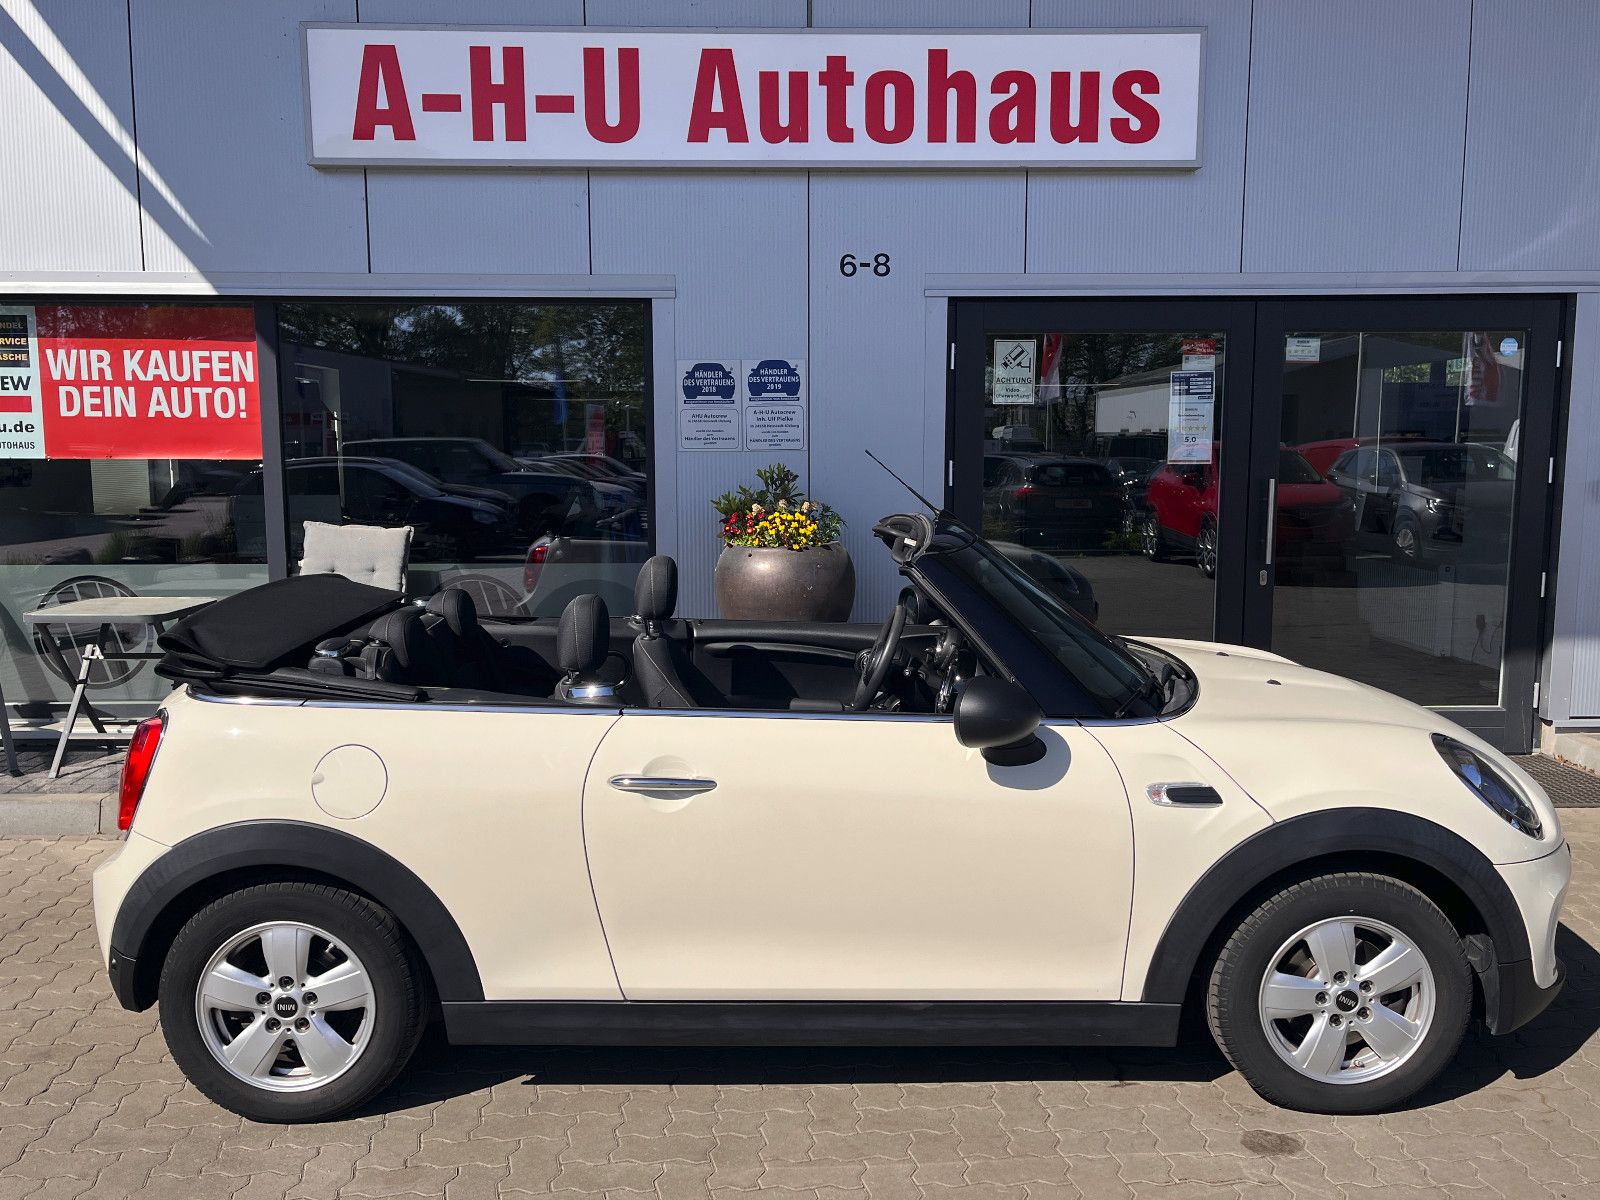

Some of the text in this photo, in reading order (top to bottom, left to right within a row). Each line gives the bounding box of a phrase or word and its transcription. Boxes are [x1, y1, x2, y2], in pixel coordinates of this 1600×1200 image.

[352, 44, 1161, 145] A-H-U Autohaus
[839, 253, 891, 278] 6-8
[45, 348, 255, 383] WIR KAUFEN
[694, 369, 723, 378] HÄNDLER
[0, 376, 32, 391] EW
[683, 378, 735, 386] DES VERTRAUENS
[58, 386, 137, 418] DEIN
[147, 387, 247, 419] AUTO!
[277, 1003, 296, 1011] MINI
[1338, 994, 1357, 1008] MINI
